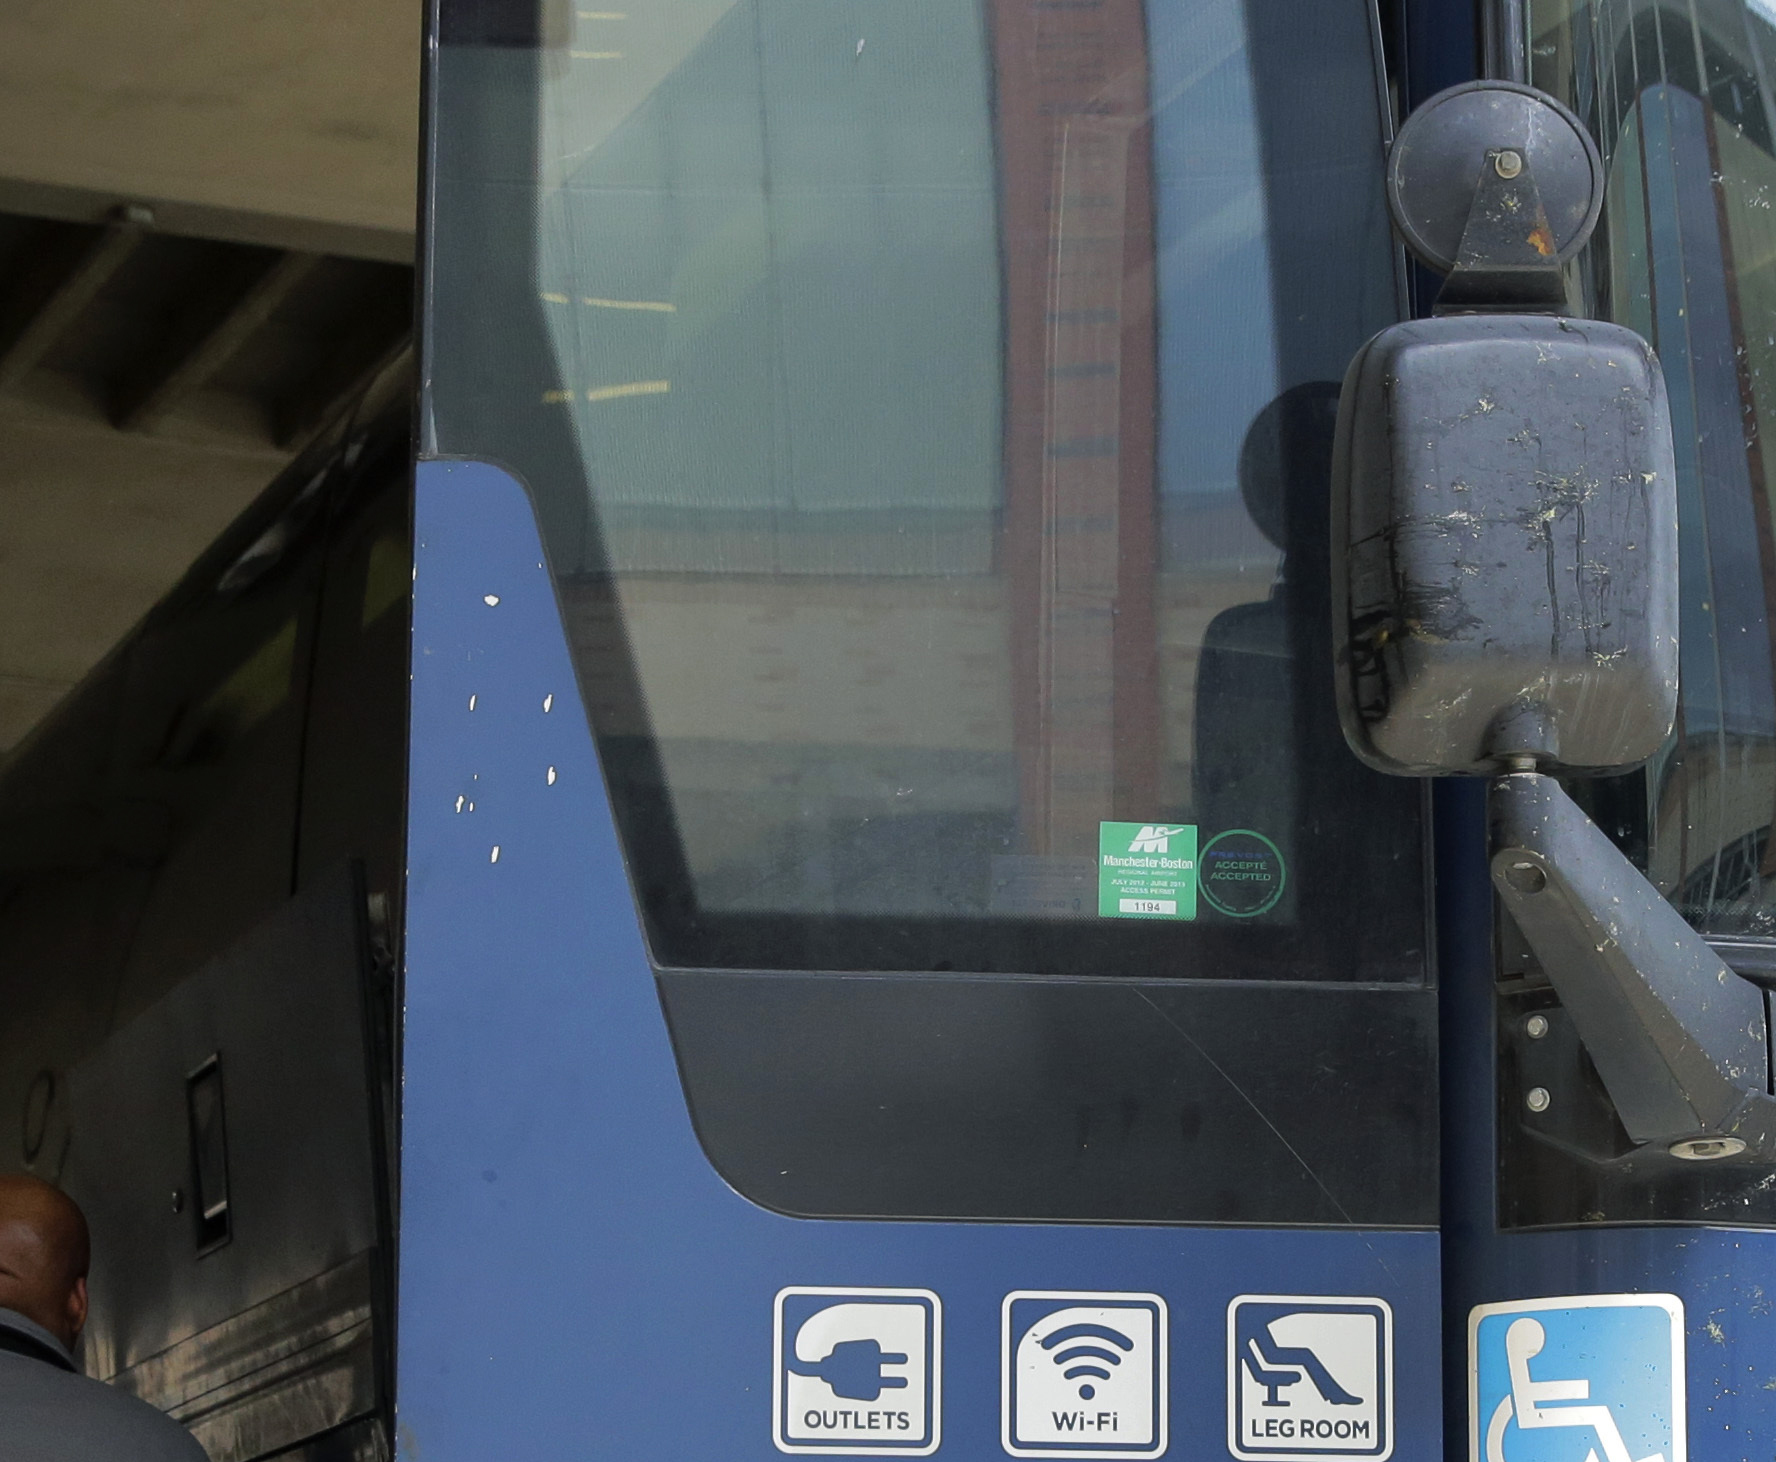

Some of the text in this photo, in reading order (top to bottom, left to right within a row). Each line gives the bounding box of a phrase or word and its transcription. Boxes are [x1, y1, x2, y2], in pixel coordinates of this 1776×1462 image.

[1214, 860, 1268, 871] ACCEPTÉ
[1210, 872, 1271, 882] ACCEPTED
[1120, 887, 1149, 895] ACCESS
[1135, 902, 1161, 912] 1194
[803, 1409, 911, 1432] OUTLETS
[1051, 1410, 1120, 1433] Wi-Fi
[1250, 1417, 1372, 1441] LEG ROOM
